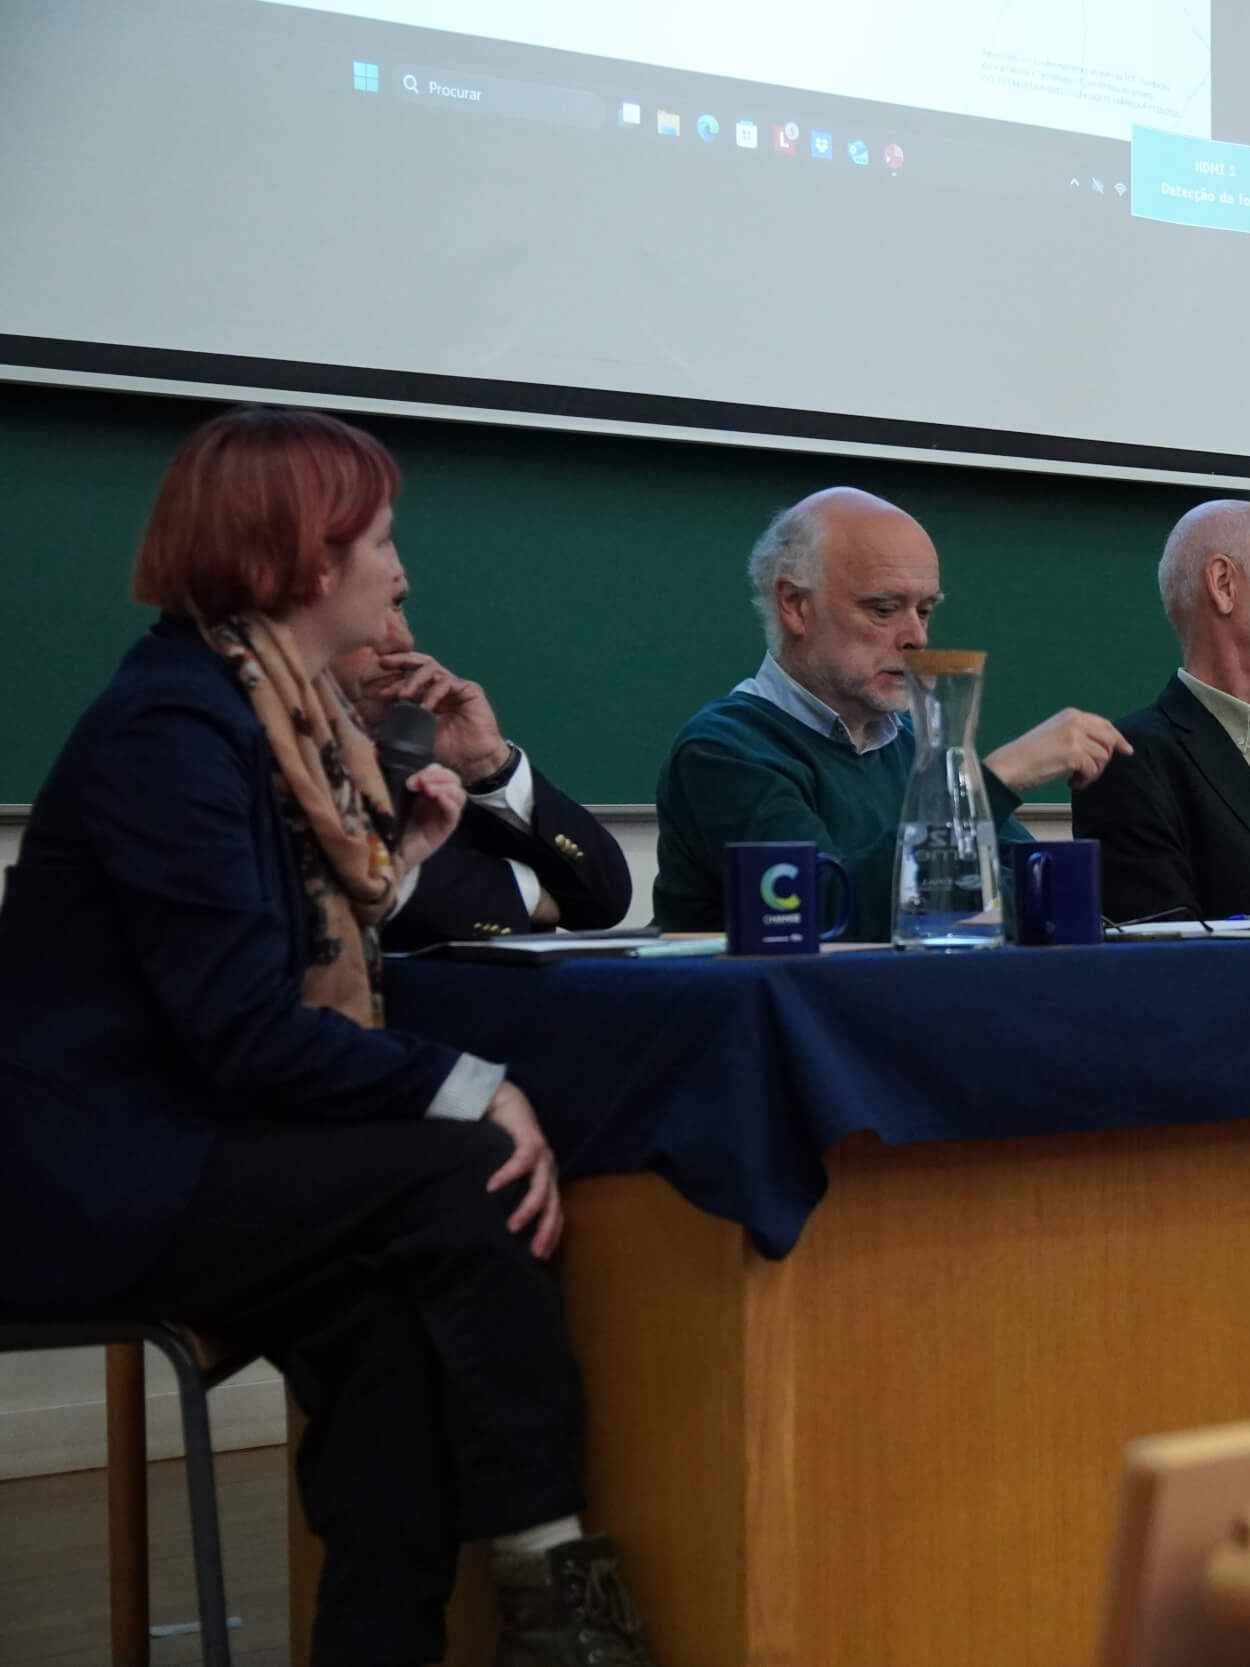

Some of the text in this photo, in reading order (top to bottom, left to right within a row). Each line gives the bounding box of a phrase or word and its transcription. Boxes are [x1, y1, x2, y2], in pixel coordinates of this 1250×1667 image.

[428, 80, 482, 102] Procurar
[1194, 160, 1225, 176] HDMI
[1161, 181, 1216, 205] Detecção
